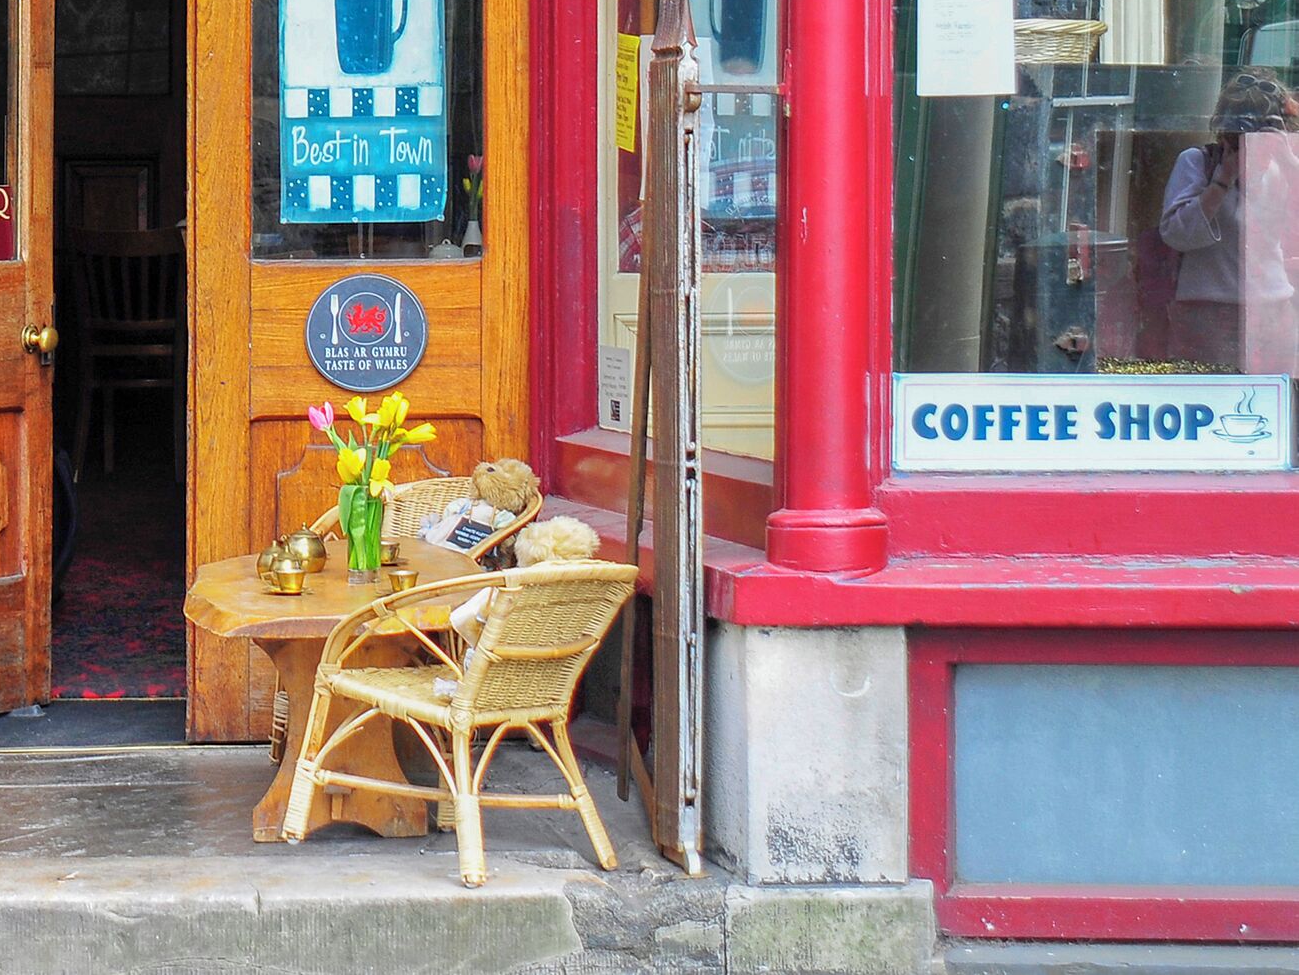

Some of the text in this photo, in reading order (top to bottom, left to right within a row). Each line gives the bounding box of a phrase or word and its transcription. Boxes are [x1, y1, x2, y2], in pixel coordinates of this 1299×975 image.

[291, 125, 433, 167] Best in Town
[324, 345, 408, 358] BLAS AR GYMRU
[324, 358, 408, 371] TASTE OF WALES
[910, 400, 1215, 442] COFFEE SHOP
